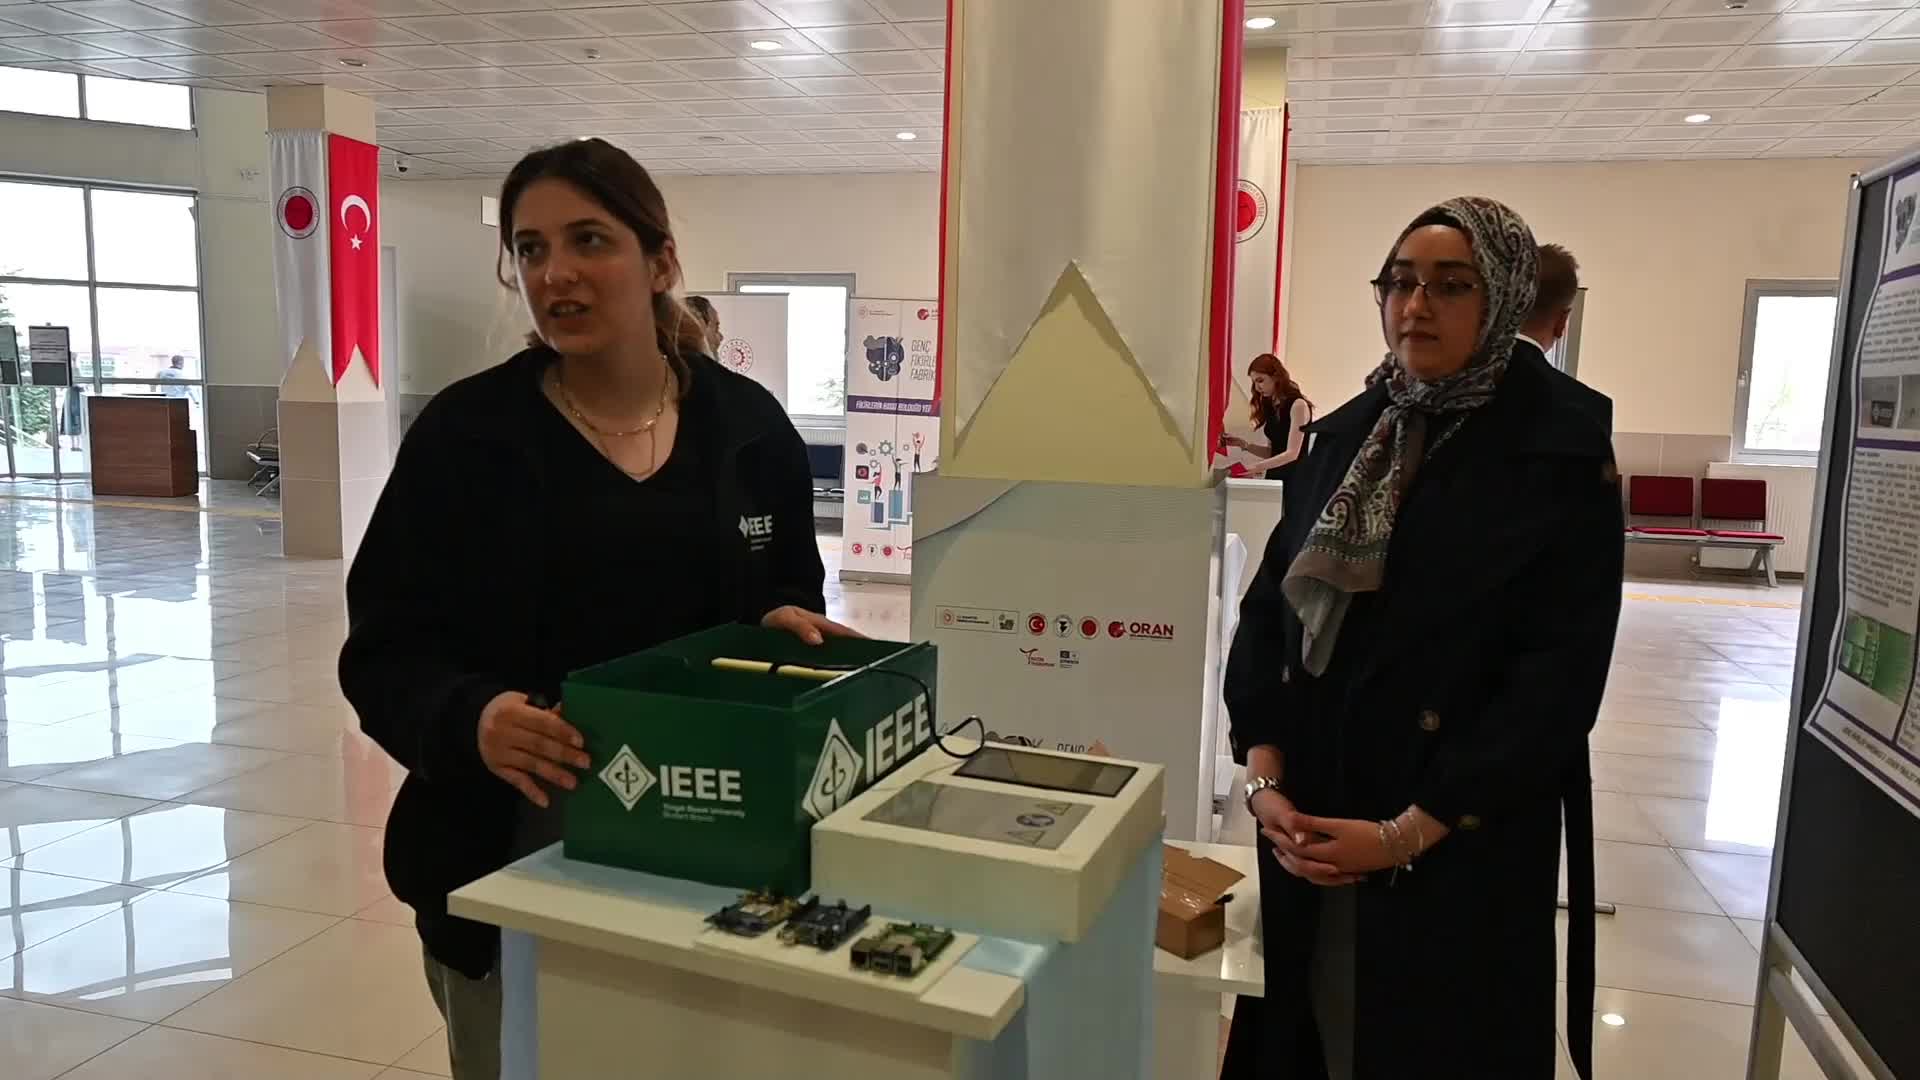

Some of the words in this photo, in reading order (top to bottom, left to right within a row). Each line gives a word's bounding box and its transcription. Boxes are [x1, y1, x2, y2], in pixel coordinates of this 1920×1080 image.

[1130, 622, 1174, 636] ORAN
[865, 692, 930, 785] IEEE
[660, 764, 742, 802] IEEE
